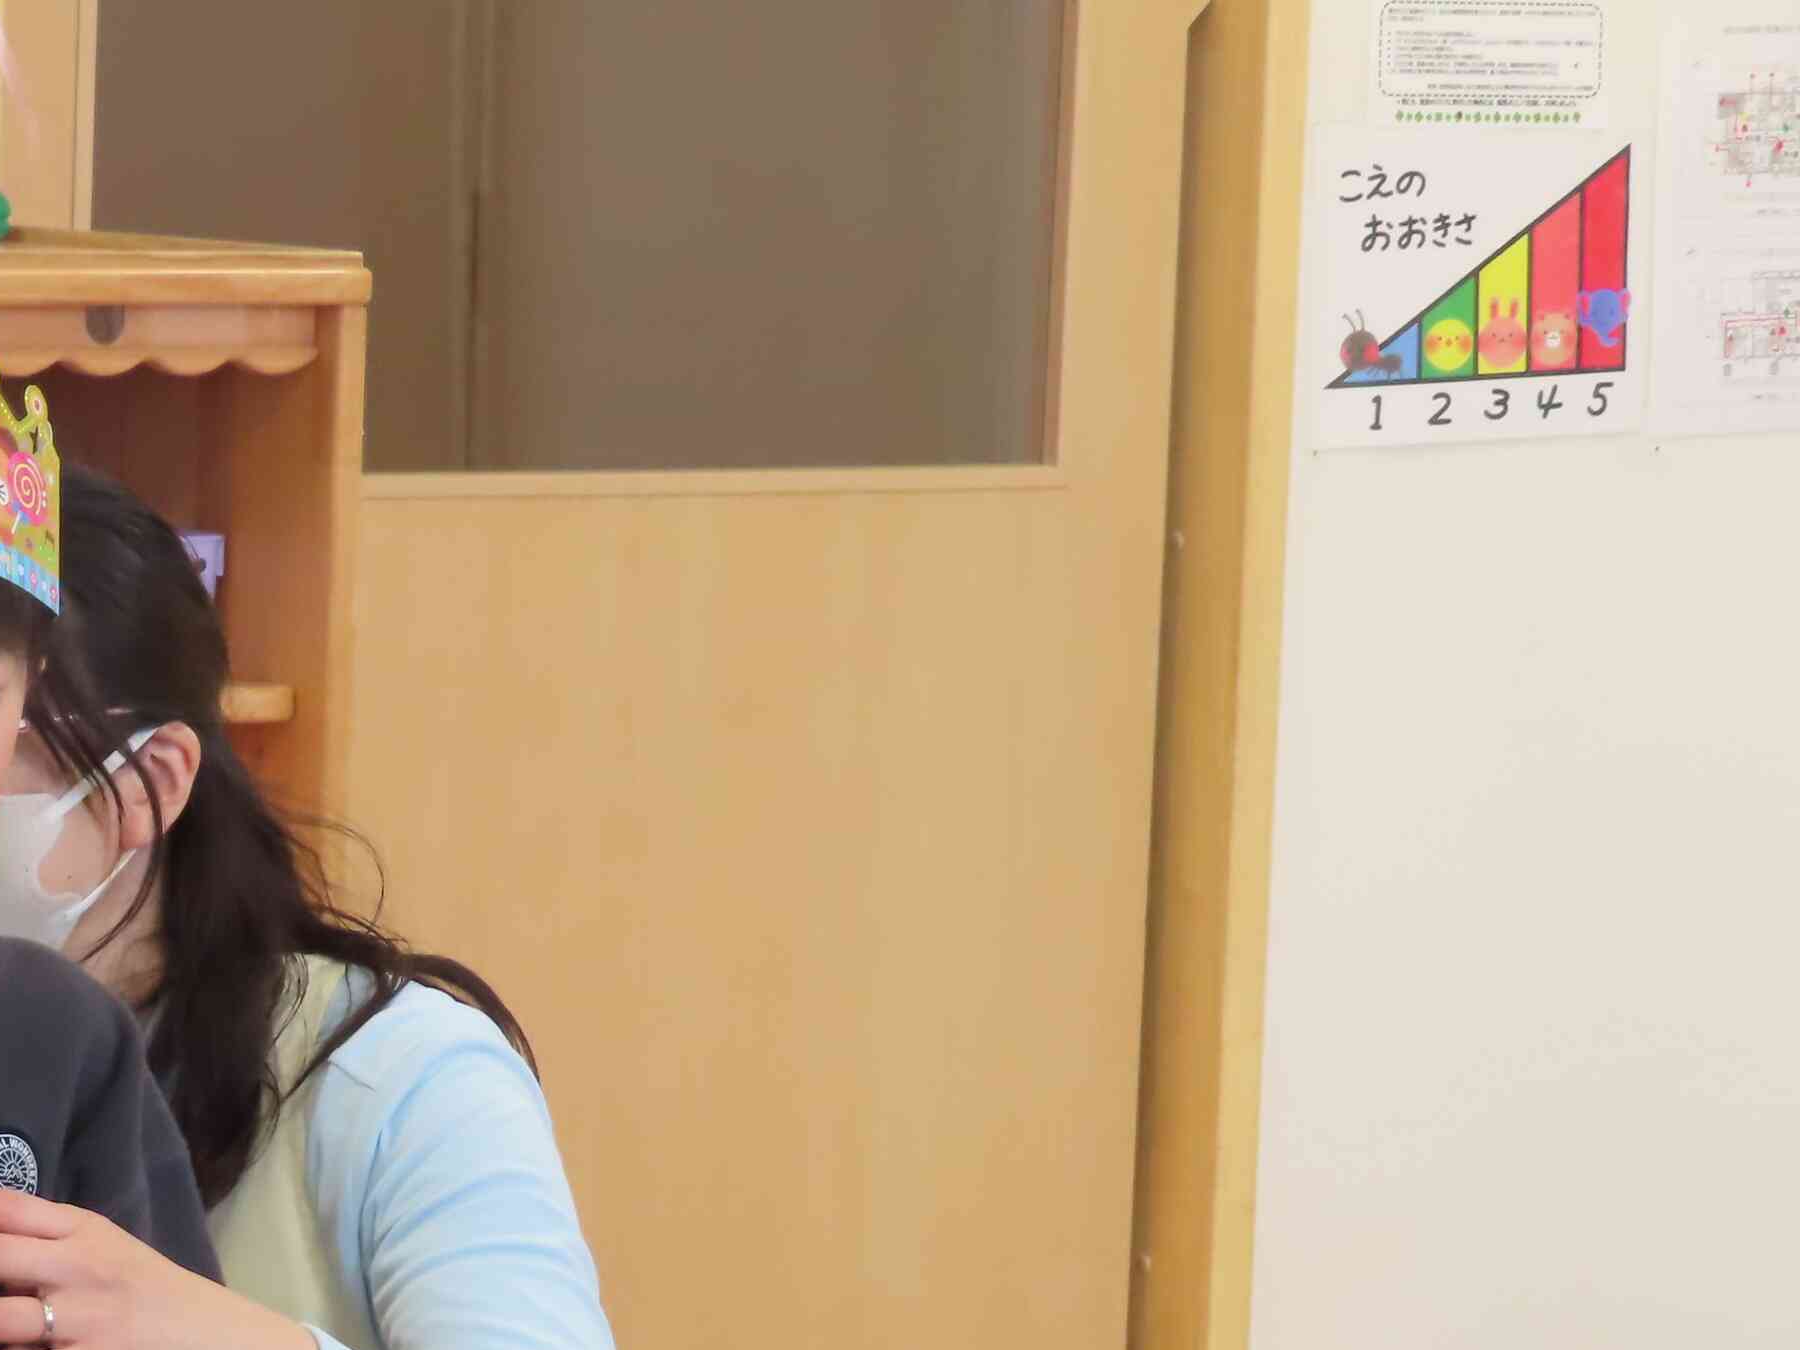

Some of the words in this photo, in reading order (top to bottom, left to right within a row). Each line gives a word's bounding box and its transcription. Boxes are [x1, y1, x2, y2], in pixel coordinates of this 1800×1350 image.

[1338, 163, 1426, 203] こえの
[1360, 213, 1477, 252] おおきさ
[1369, 394, 1382, 431] 1
[1427, 391, 1453, 426] 2
[1483, 388, 1511, 421] 3
[1536, 384, 1563, 419] 4
[1586, 381, 1615, 417] 5
